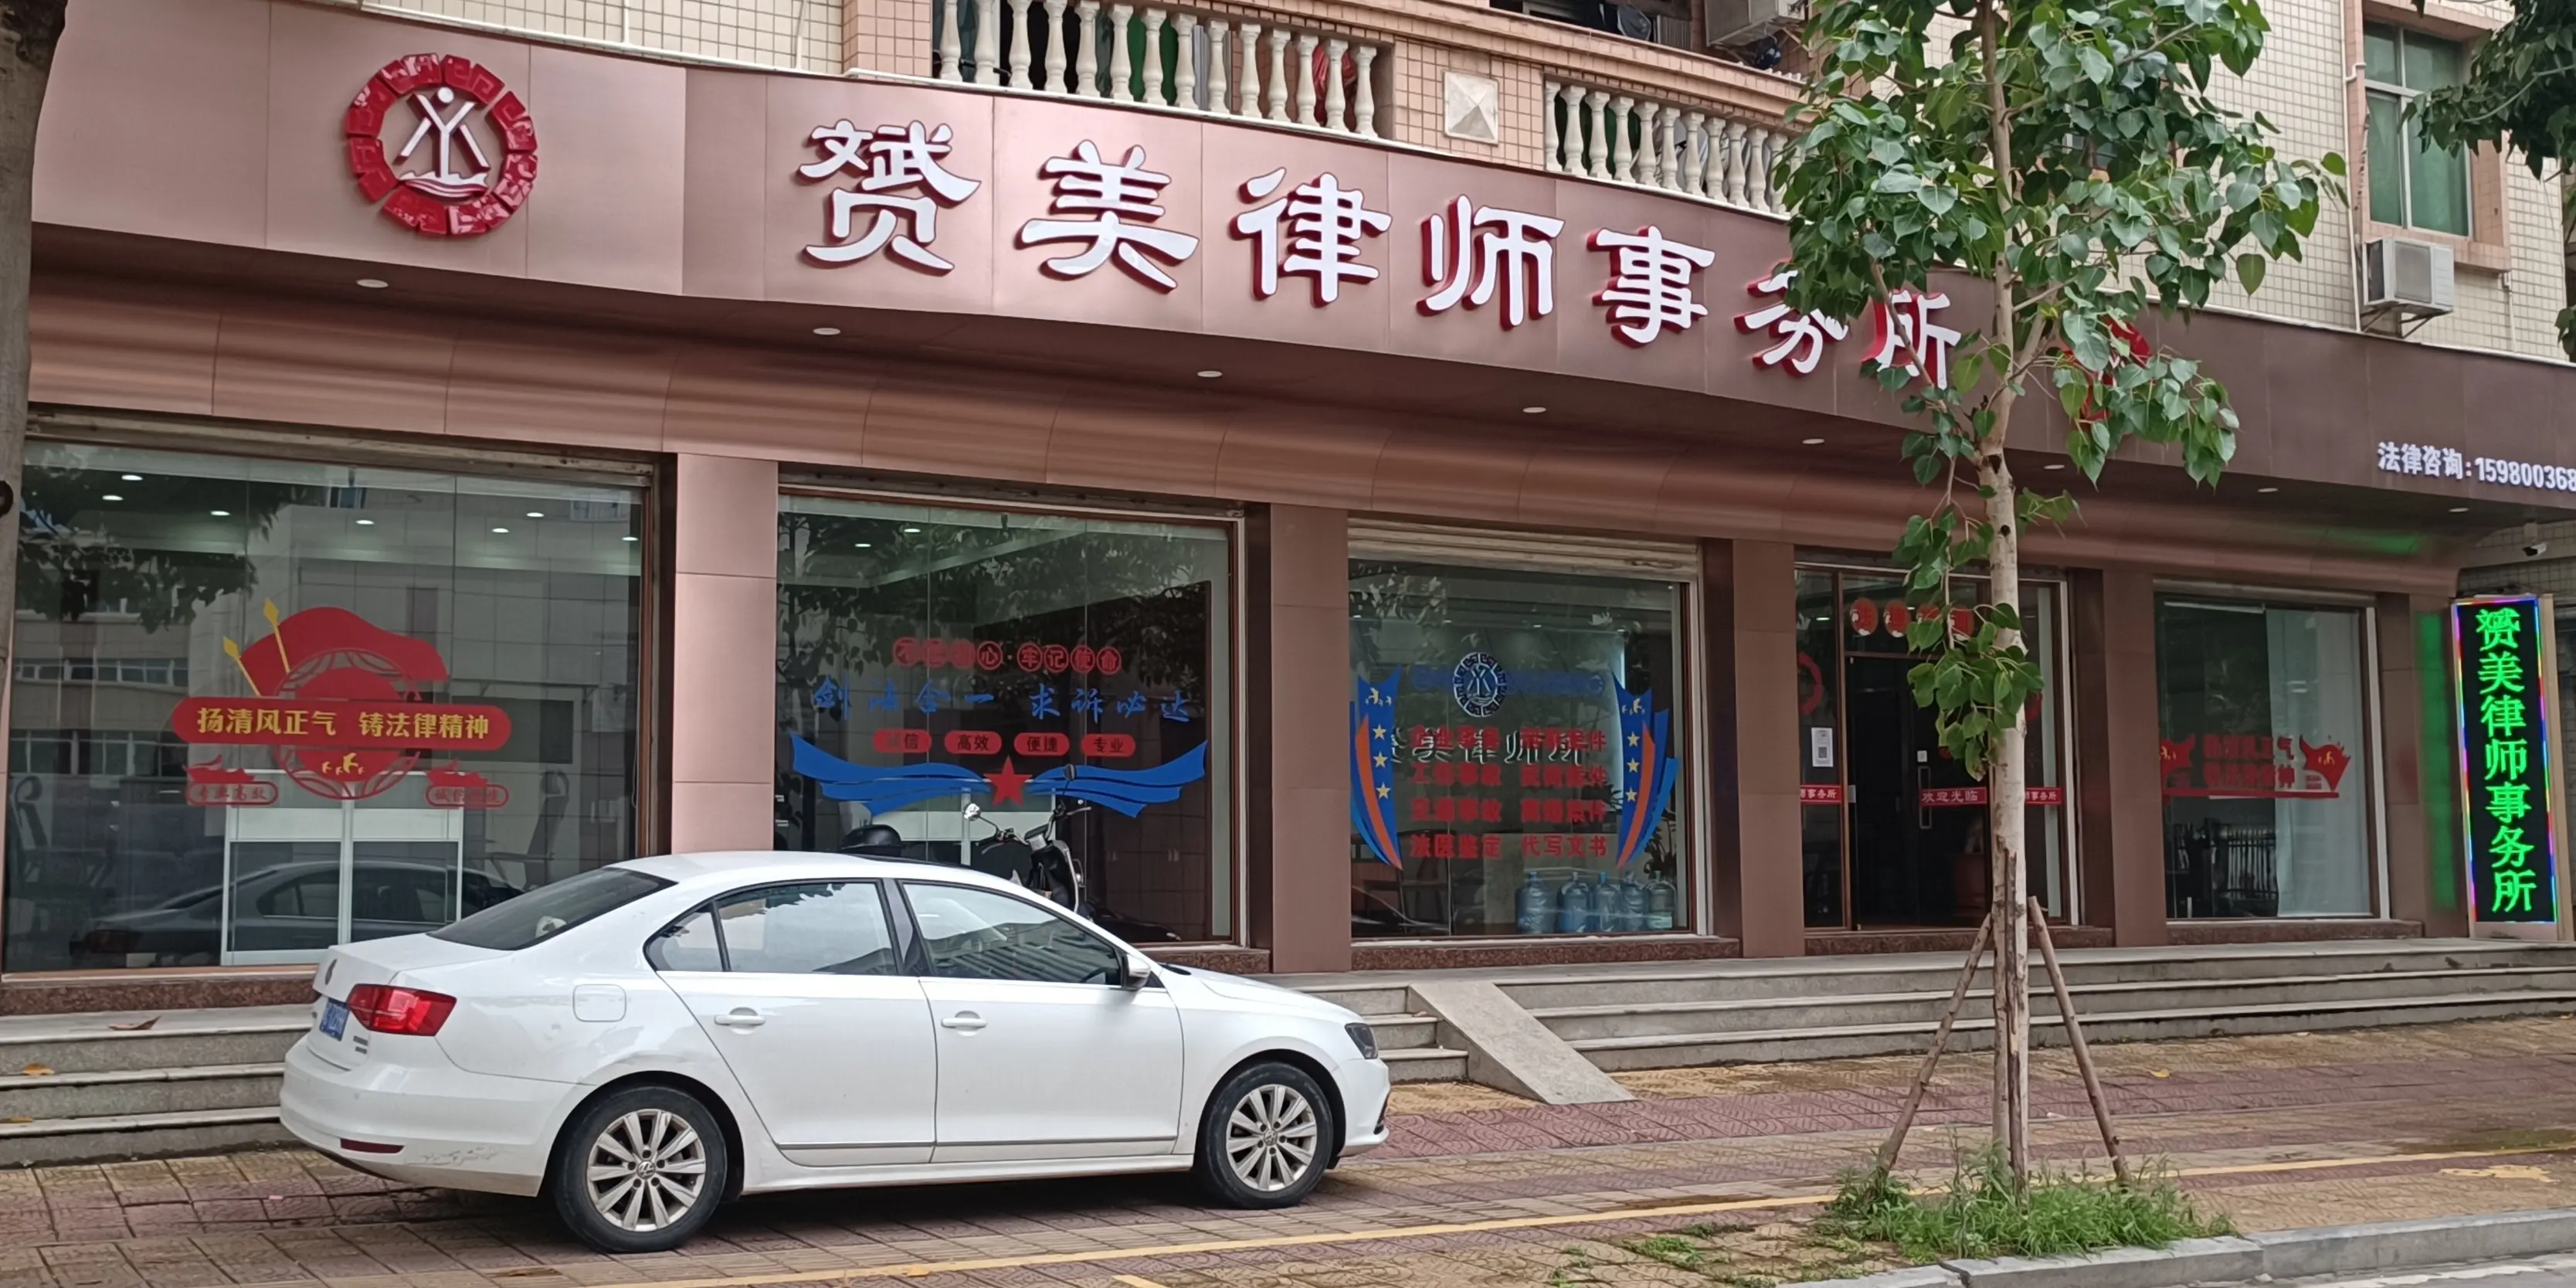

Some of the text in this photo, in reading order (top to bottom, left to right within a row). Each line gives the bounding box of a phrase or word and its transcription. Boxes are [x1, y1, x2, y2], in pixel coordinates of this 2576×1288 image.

[798, 118, 1962, 390] 赟美律师事务所
[1019, 644, 1119, 672] 牢记使命
[197, 706, 489, 739] 扬清风正气 铸法律精神
[956, 734, 989, 751] 高效
[1027, 736, 1058, 752] 便捷
[1093, 736, 1125, 753] 专业
[2475, 607, 2537, 912] 赟美律师事务所
[1921, 788, 1978, 802] 欢迎光临
[1522, 834, 1607, 858] 代写文书
